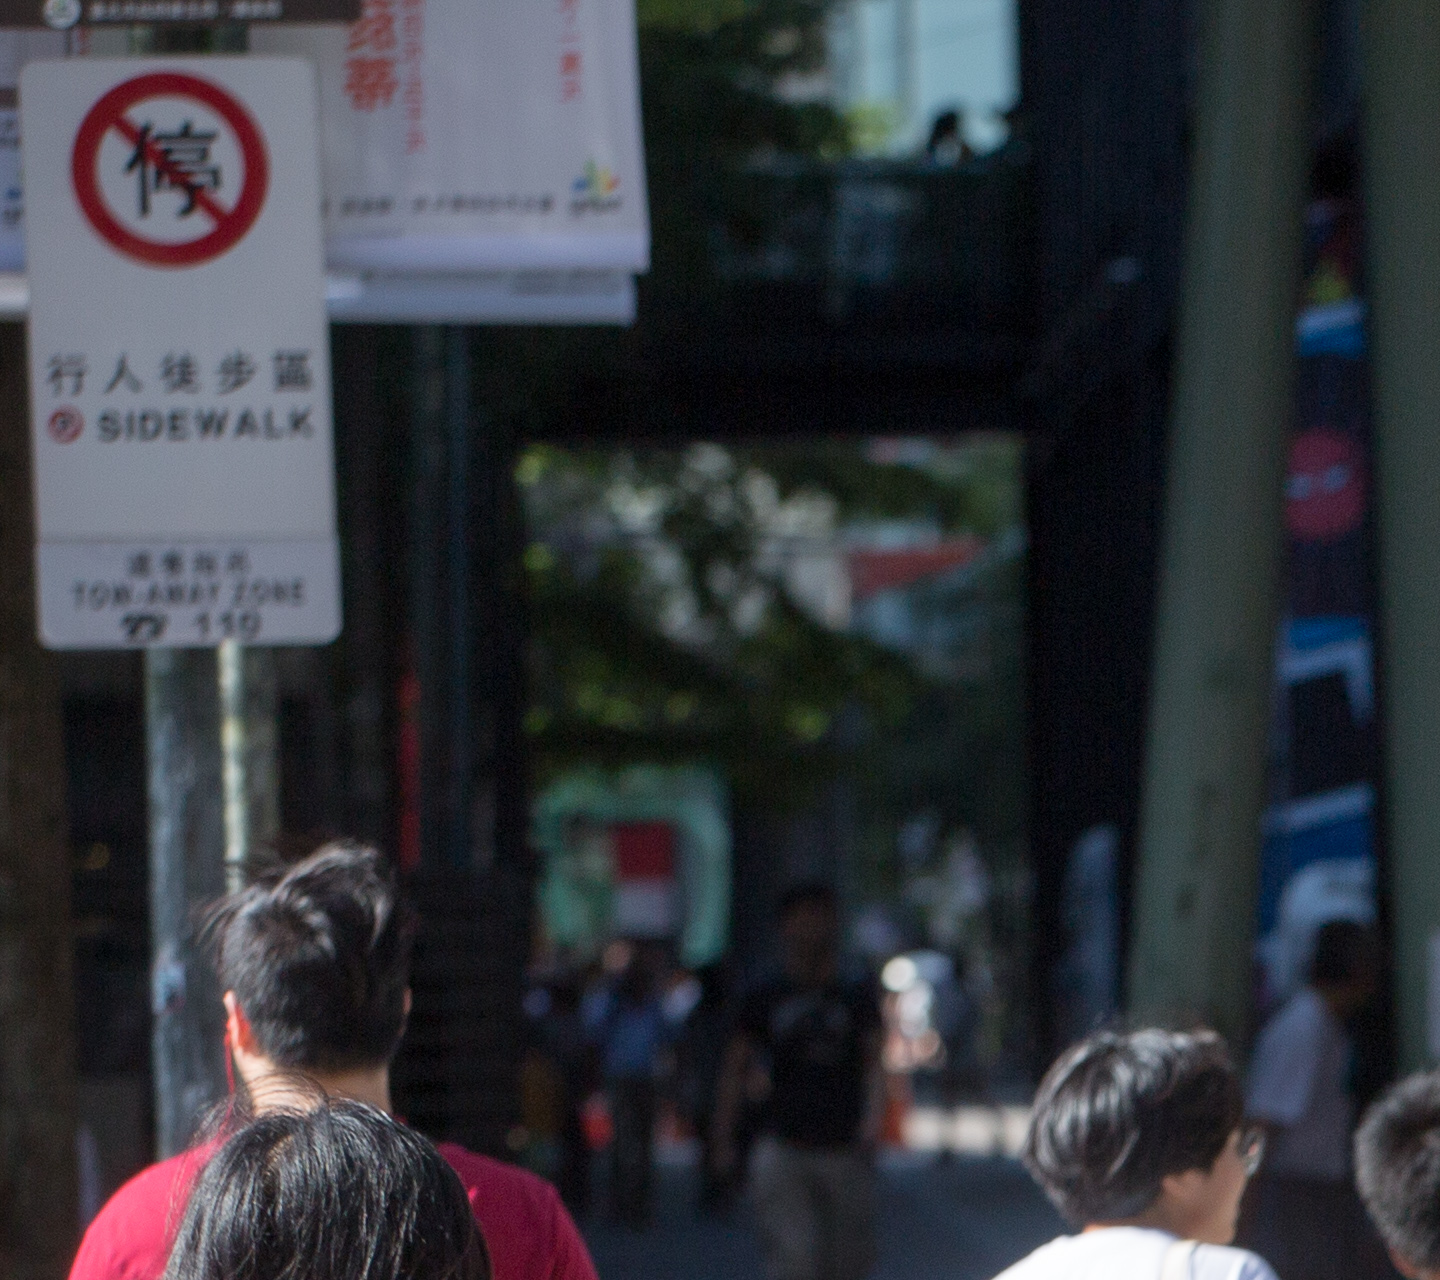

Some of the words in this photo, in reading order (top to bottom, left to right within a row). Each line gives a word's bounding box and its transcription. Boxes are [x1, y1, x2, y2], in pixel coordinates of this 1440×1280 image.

[123, 118, 221, 219] 停
[47, 349, 313, 397] 行人徒步區
[98, 405, 314, 443] SIDEWALK
[231, 577, 306, 609] ZONE
[196, 610, 262, 641] 110
